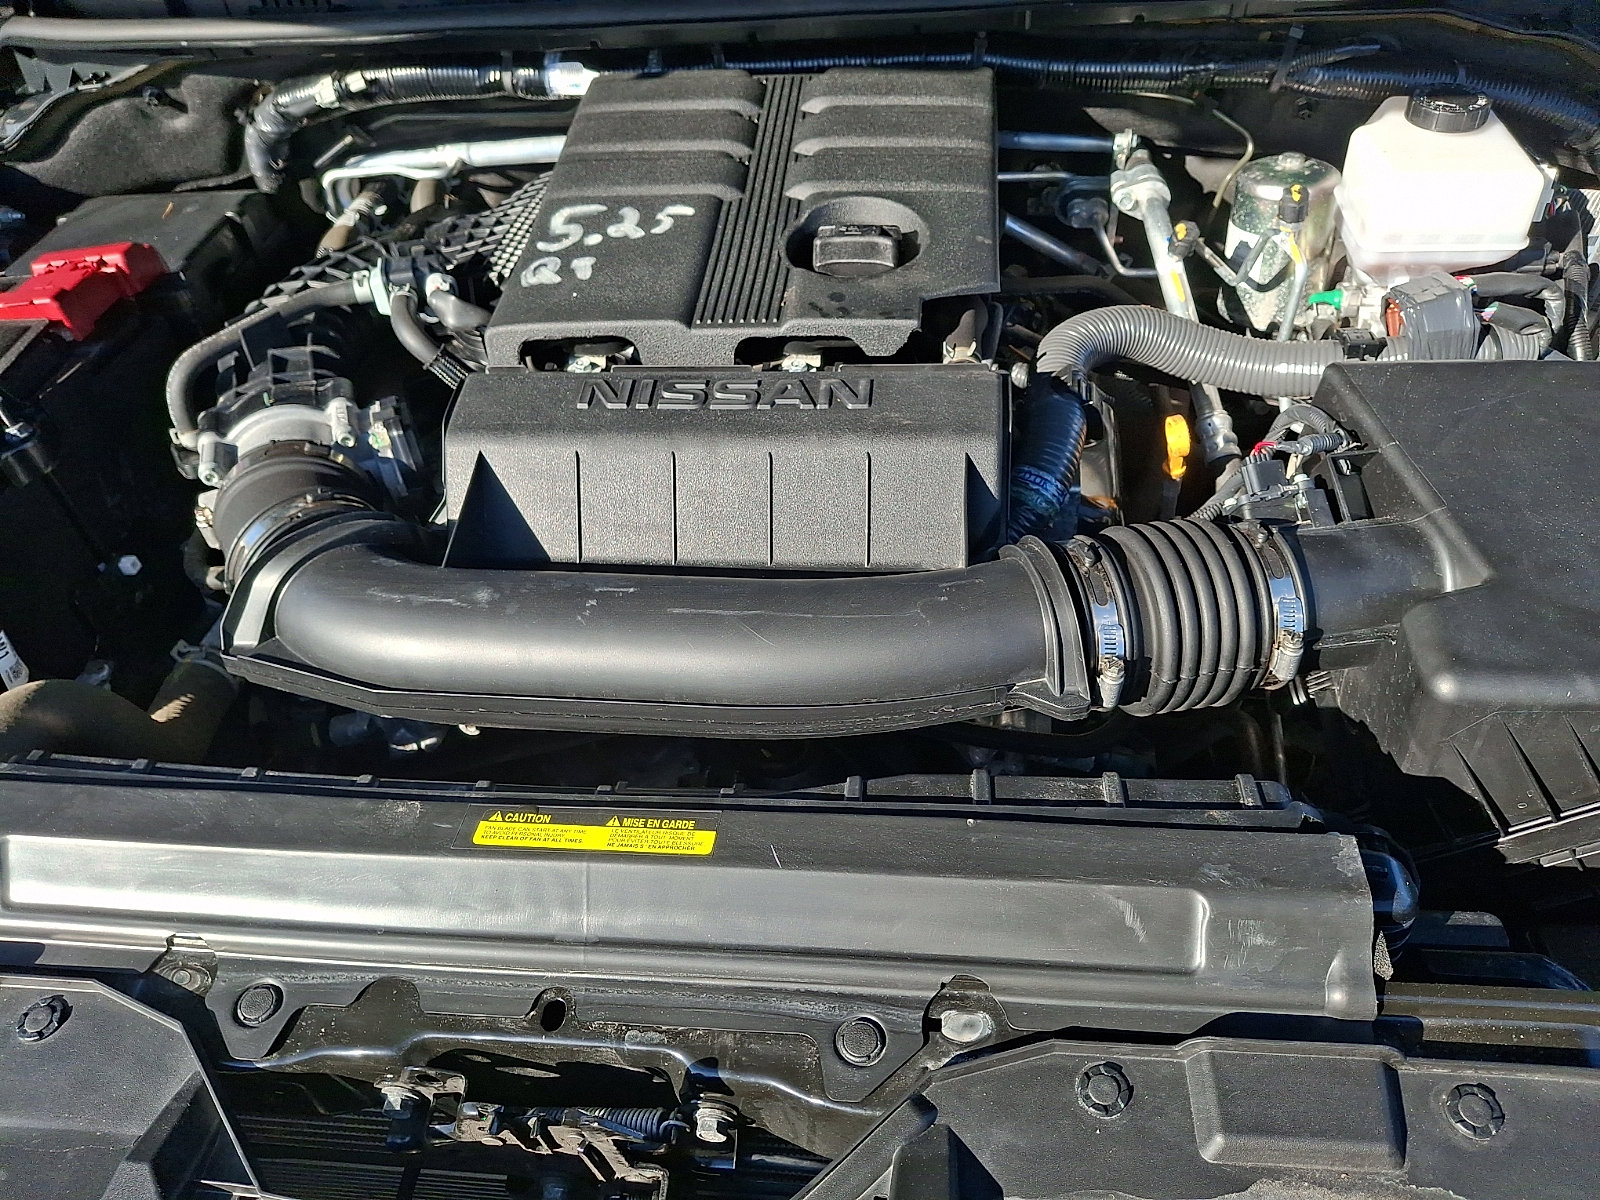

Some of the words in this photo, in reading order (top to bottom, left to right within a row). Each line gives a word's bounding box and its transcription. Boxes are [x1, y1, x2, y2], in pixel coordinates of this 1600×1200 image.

[537, 204, 696, 252] 5.25
[576, 378, 874, 410] NISSAN
[504, 812, 552, 824] CAUTION
[622, 818, 646, 828] MISE
[646, 818, 660, 828] EN
[662, 820, 696, 830] GARDE
